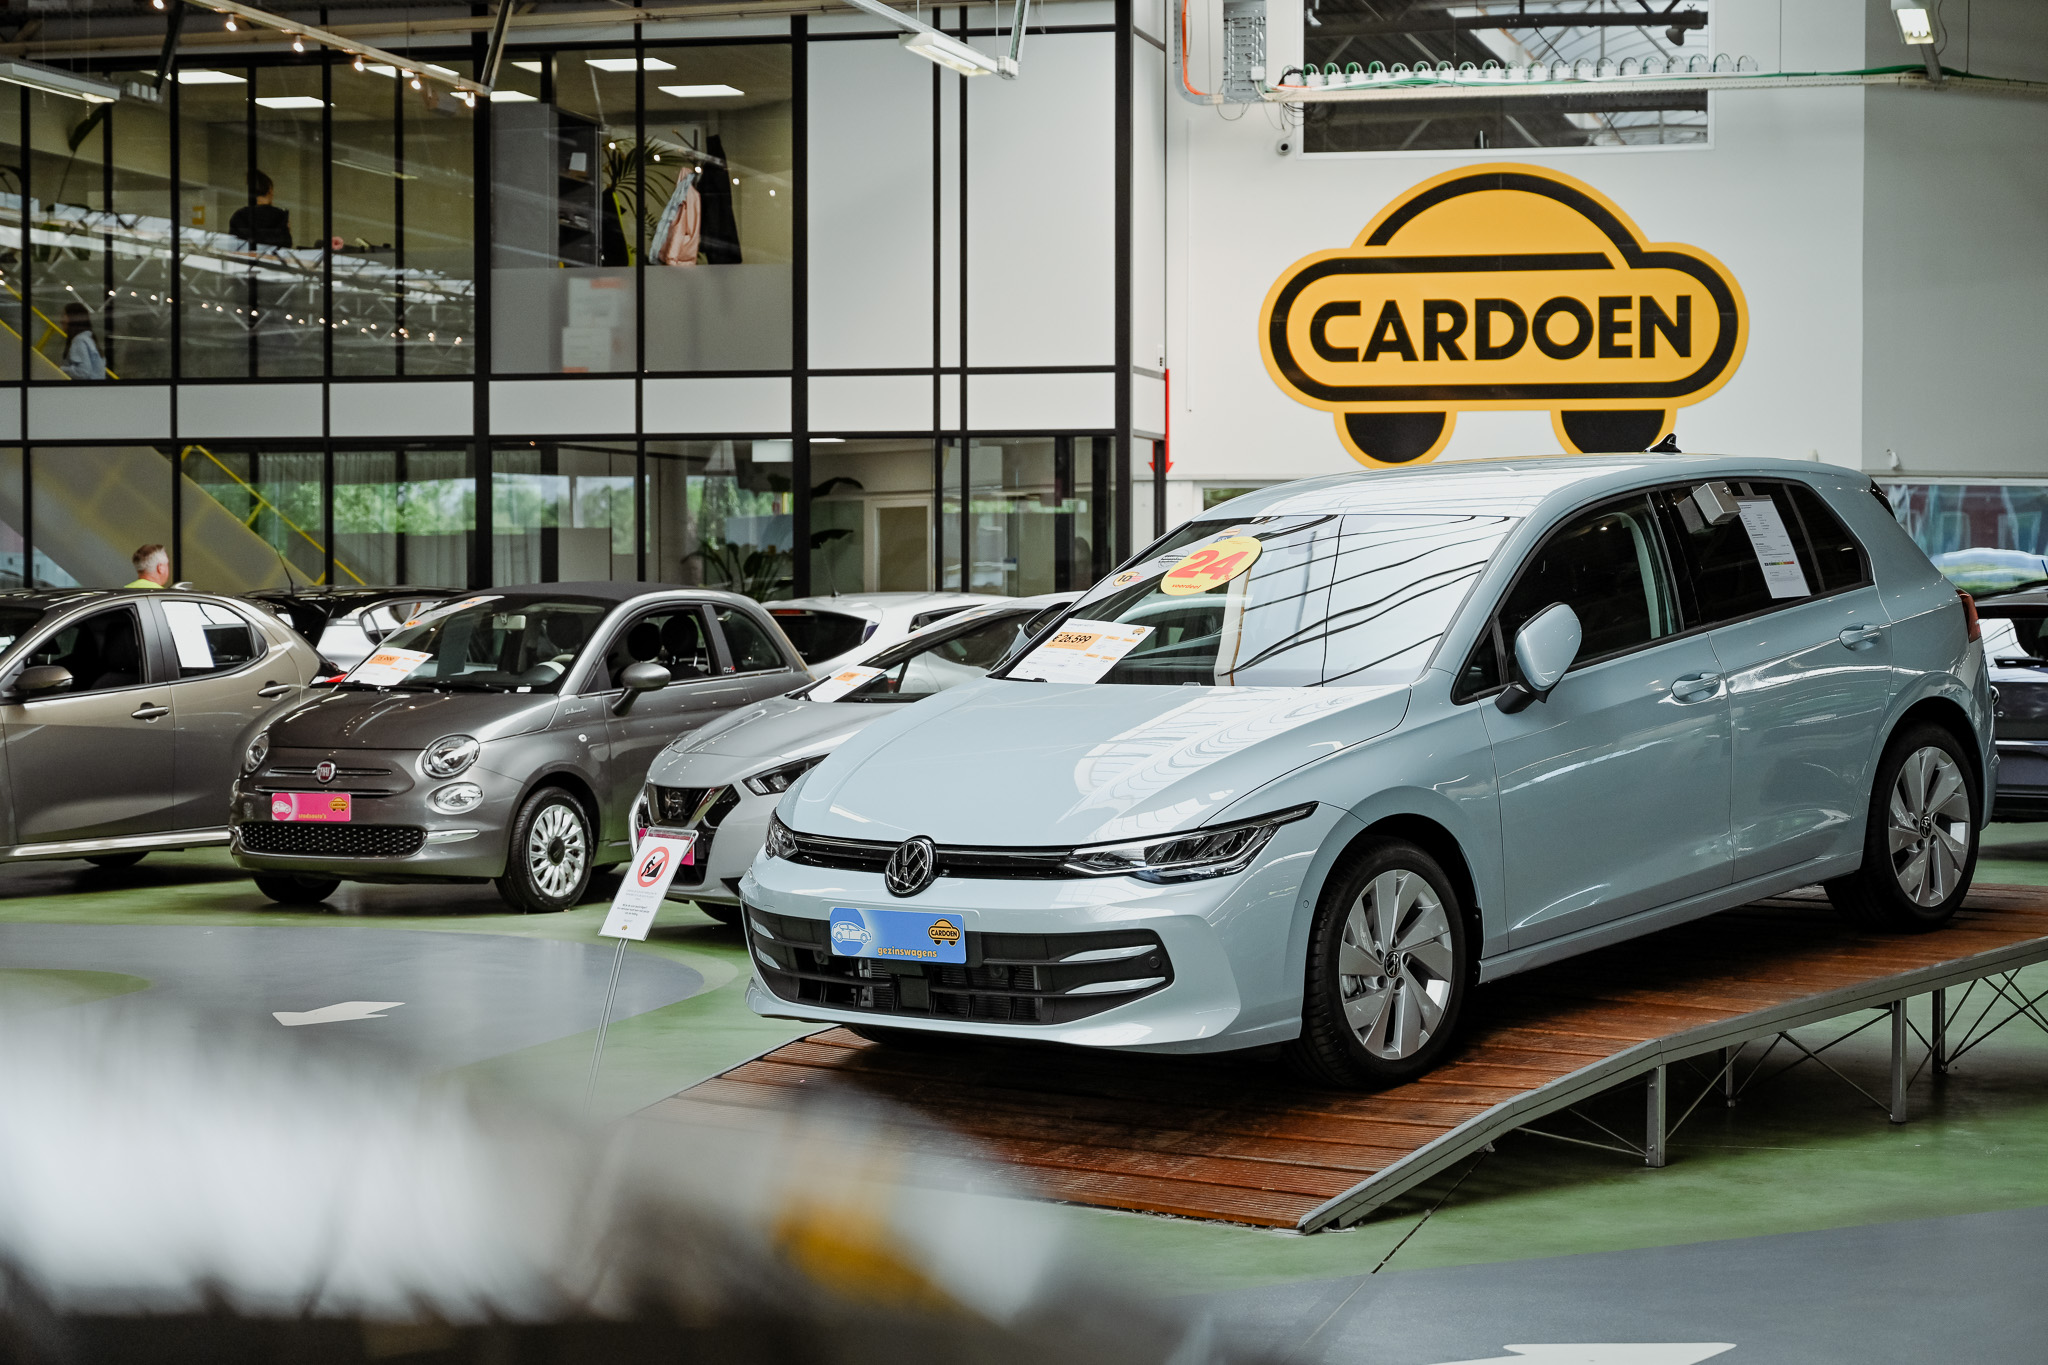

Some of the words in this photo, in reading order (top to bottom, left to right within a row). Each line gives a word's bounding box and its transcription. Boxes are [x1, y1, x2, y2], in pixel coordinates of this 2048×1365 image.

[1309, 295, 1692, 363] CARDOEN
[1167, 550, 1249, 580] 24
[930, 929, 957, 938] CARDOEN
[877, 946, 938, 959] gezinswagens
